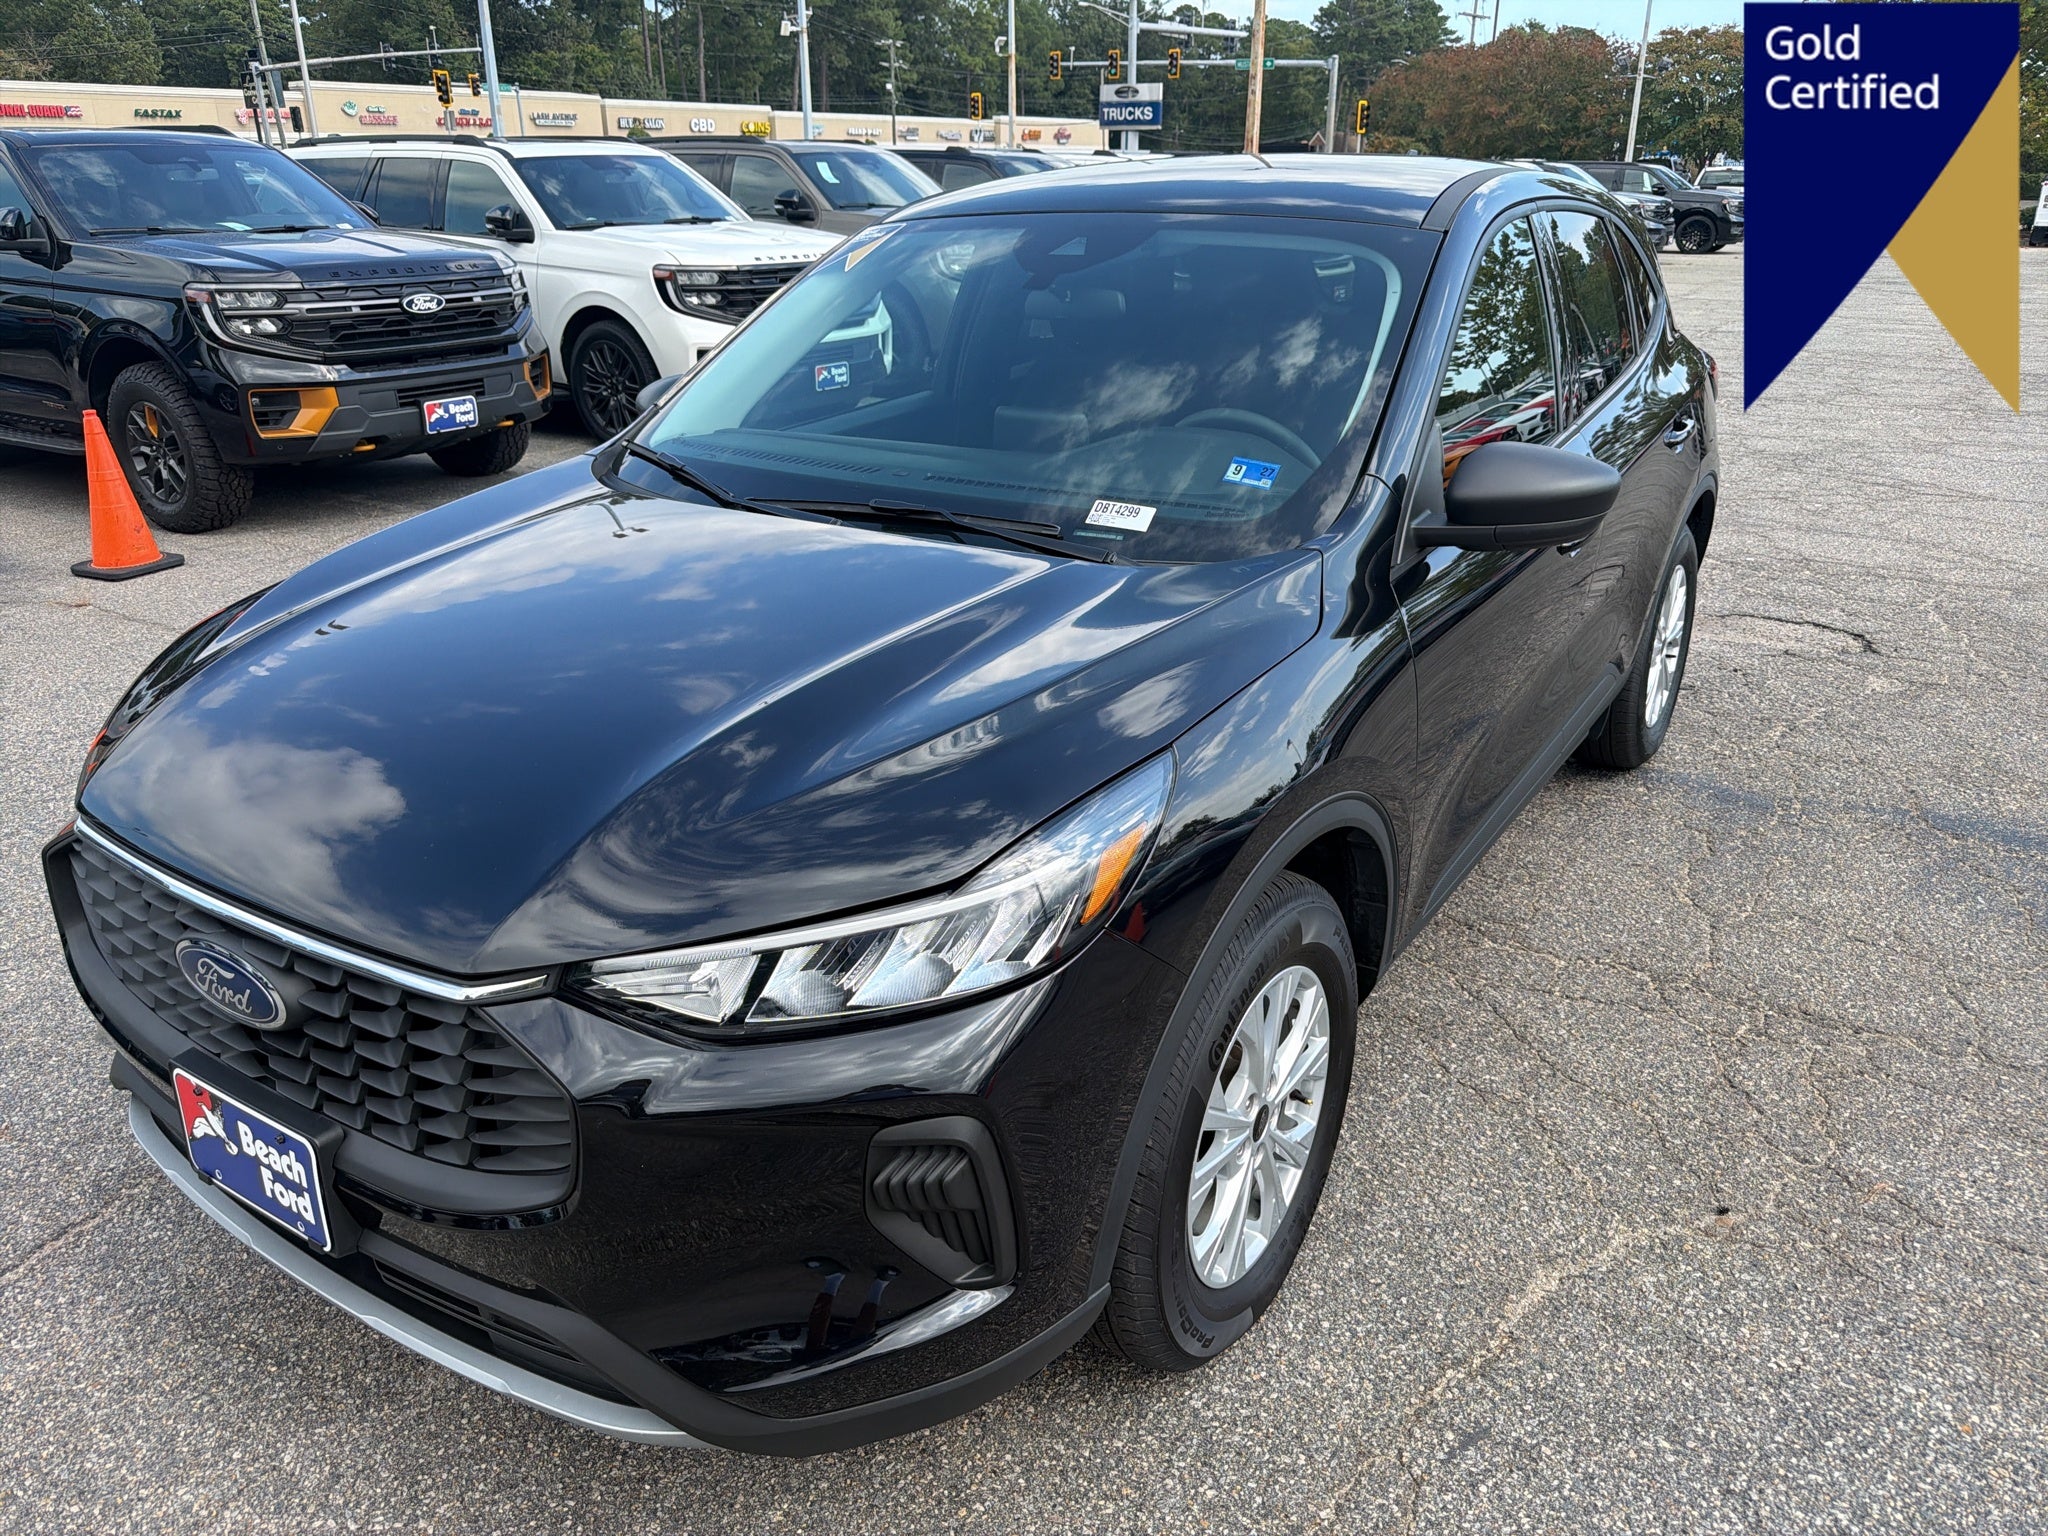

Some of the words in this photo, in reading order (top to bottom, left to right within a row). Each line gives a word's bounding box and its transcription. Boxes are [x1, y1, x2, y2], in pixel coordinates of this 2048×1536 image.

[28, 105, 66, 118] GUARD
[134, 108, 182, 118] FASTAX
[1102, 106, 1153, 121] TRUCKS
[643, 117, 666, 130] SALON
[690, 118, 715, 132] CBD
[741, 120, 771, 133] COINS
[329, 262, 479, 278] EXPEDITION
[412, 296, 438, 311] Ford
[449, 401, 474, 414] Beach
[456, 411, 475, 423] Ford
[1232, 464, 1243, 476] 9
[1260, 466, 1276, 477] 27
[1094, 501, 1141, 518] DBT4299
[195, 958, 252, 1013] Ford
[237, 1120, 309, 1190] Beach
[260, 1164, 316, 1227] Ford
